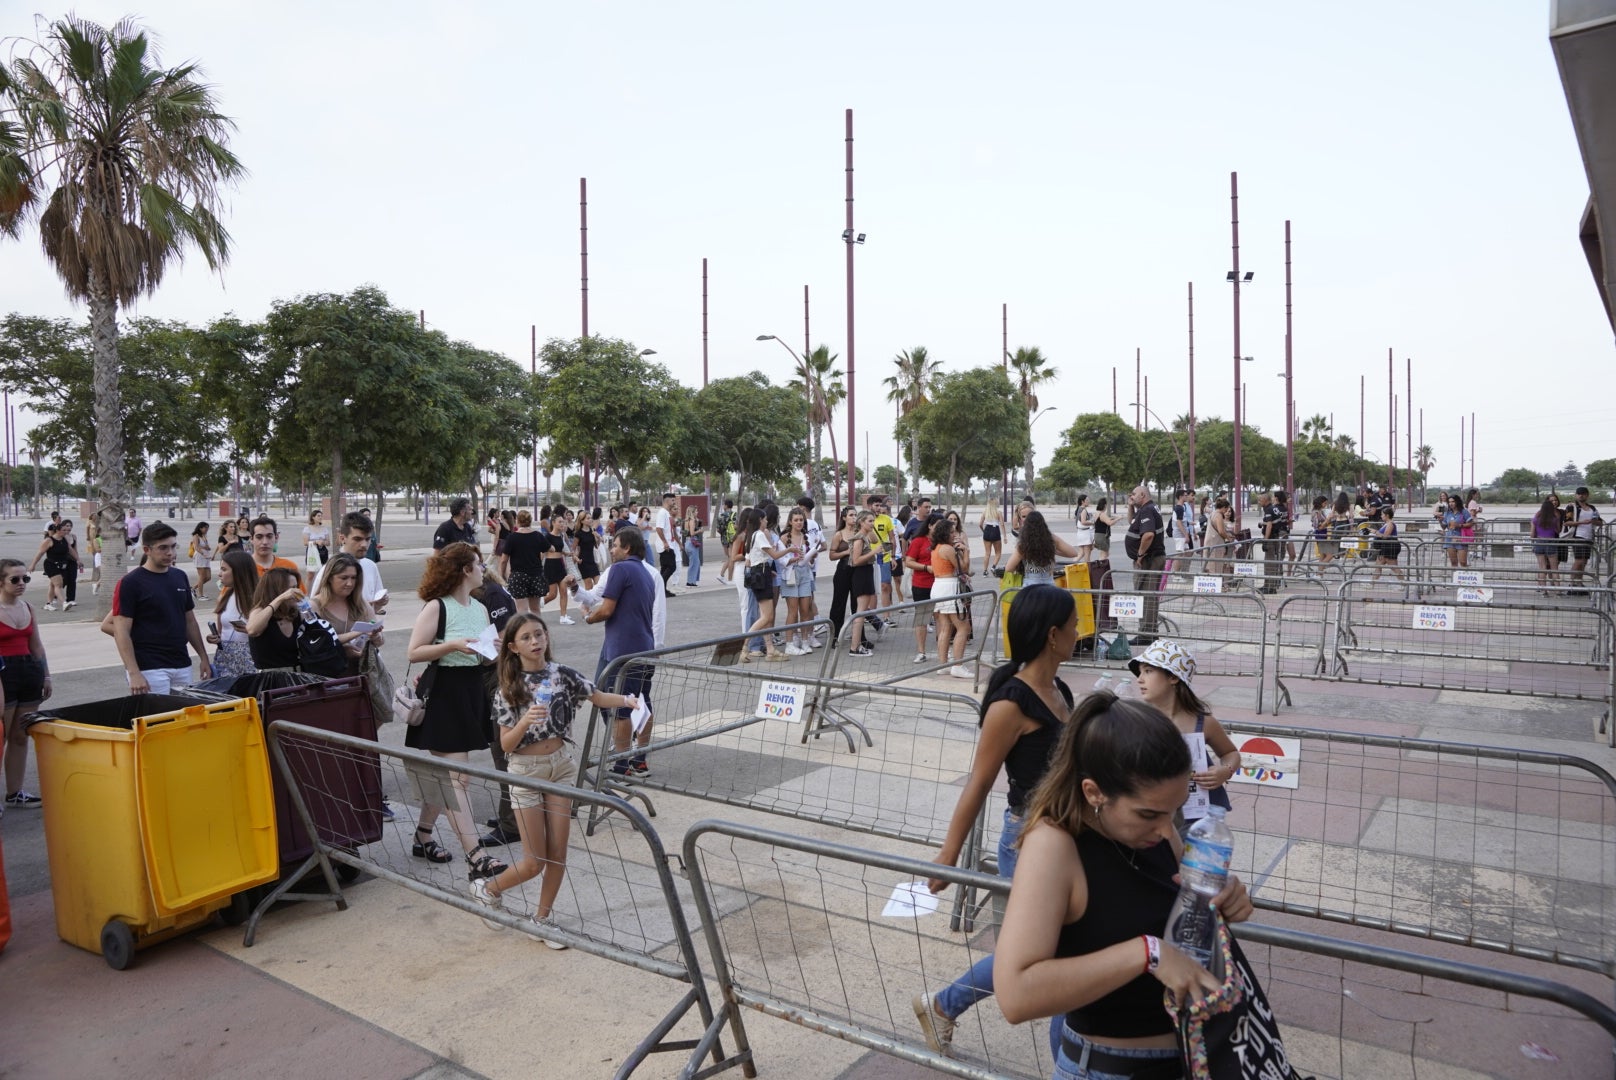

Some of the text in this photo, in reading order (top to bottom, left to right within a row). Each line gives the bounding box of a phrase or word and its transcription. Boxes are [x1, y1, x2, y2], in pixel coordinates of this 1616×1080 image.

[1420, 620, 1446, 628] TODO
[766, 692, 794, 704] RENTA
[764, 704, 792, 717] TODO
